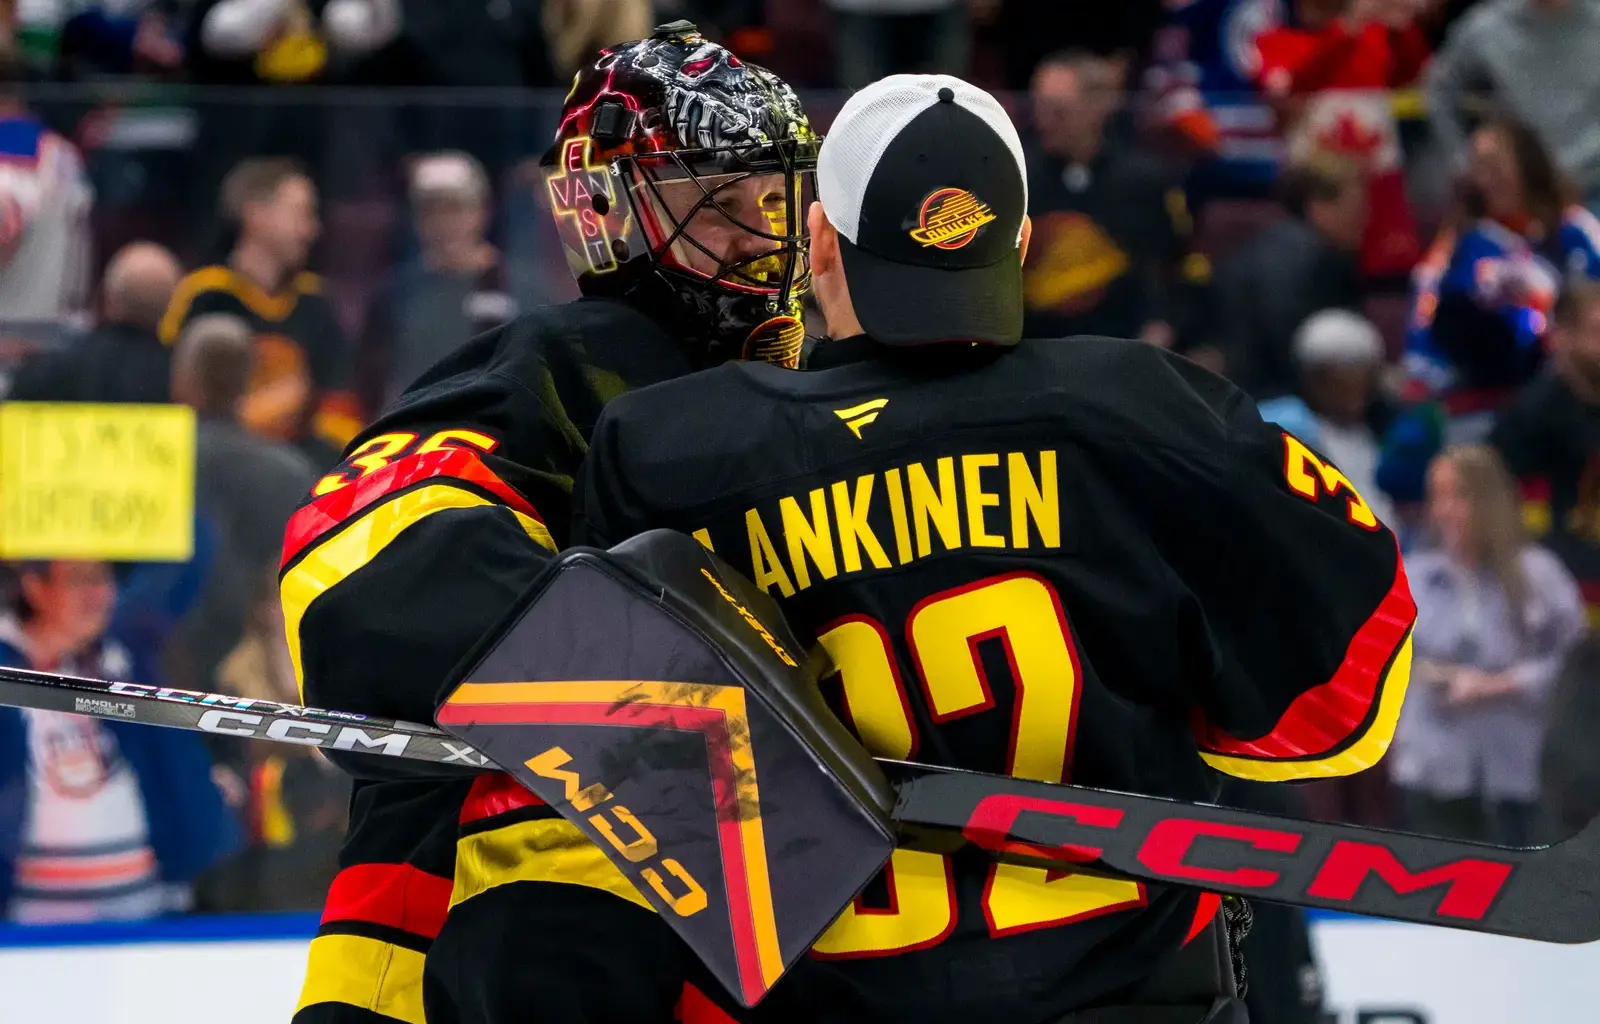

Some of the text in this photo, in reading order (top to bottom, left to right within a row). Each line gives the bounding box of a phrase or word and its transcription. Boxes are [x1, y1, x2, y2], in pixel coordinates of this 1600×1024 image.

[692, 449, 1061, 598] ANKINEN
[75, 697, 136, 711] NANOLITE
[197, 709, 490, 766] CCM X
[524, 746, 708, 917] CCM
[962, 794, 1513, 920] CCM
